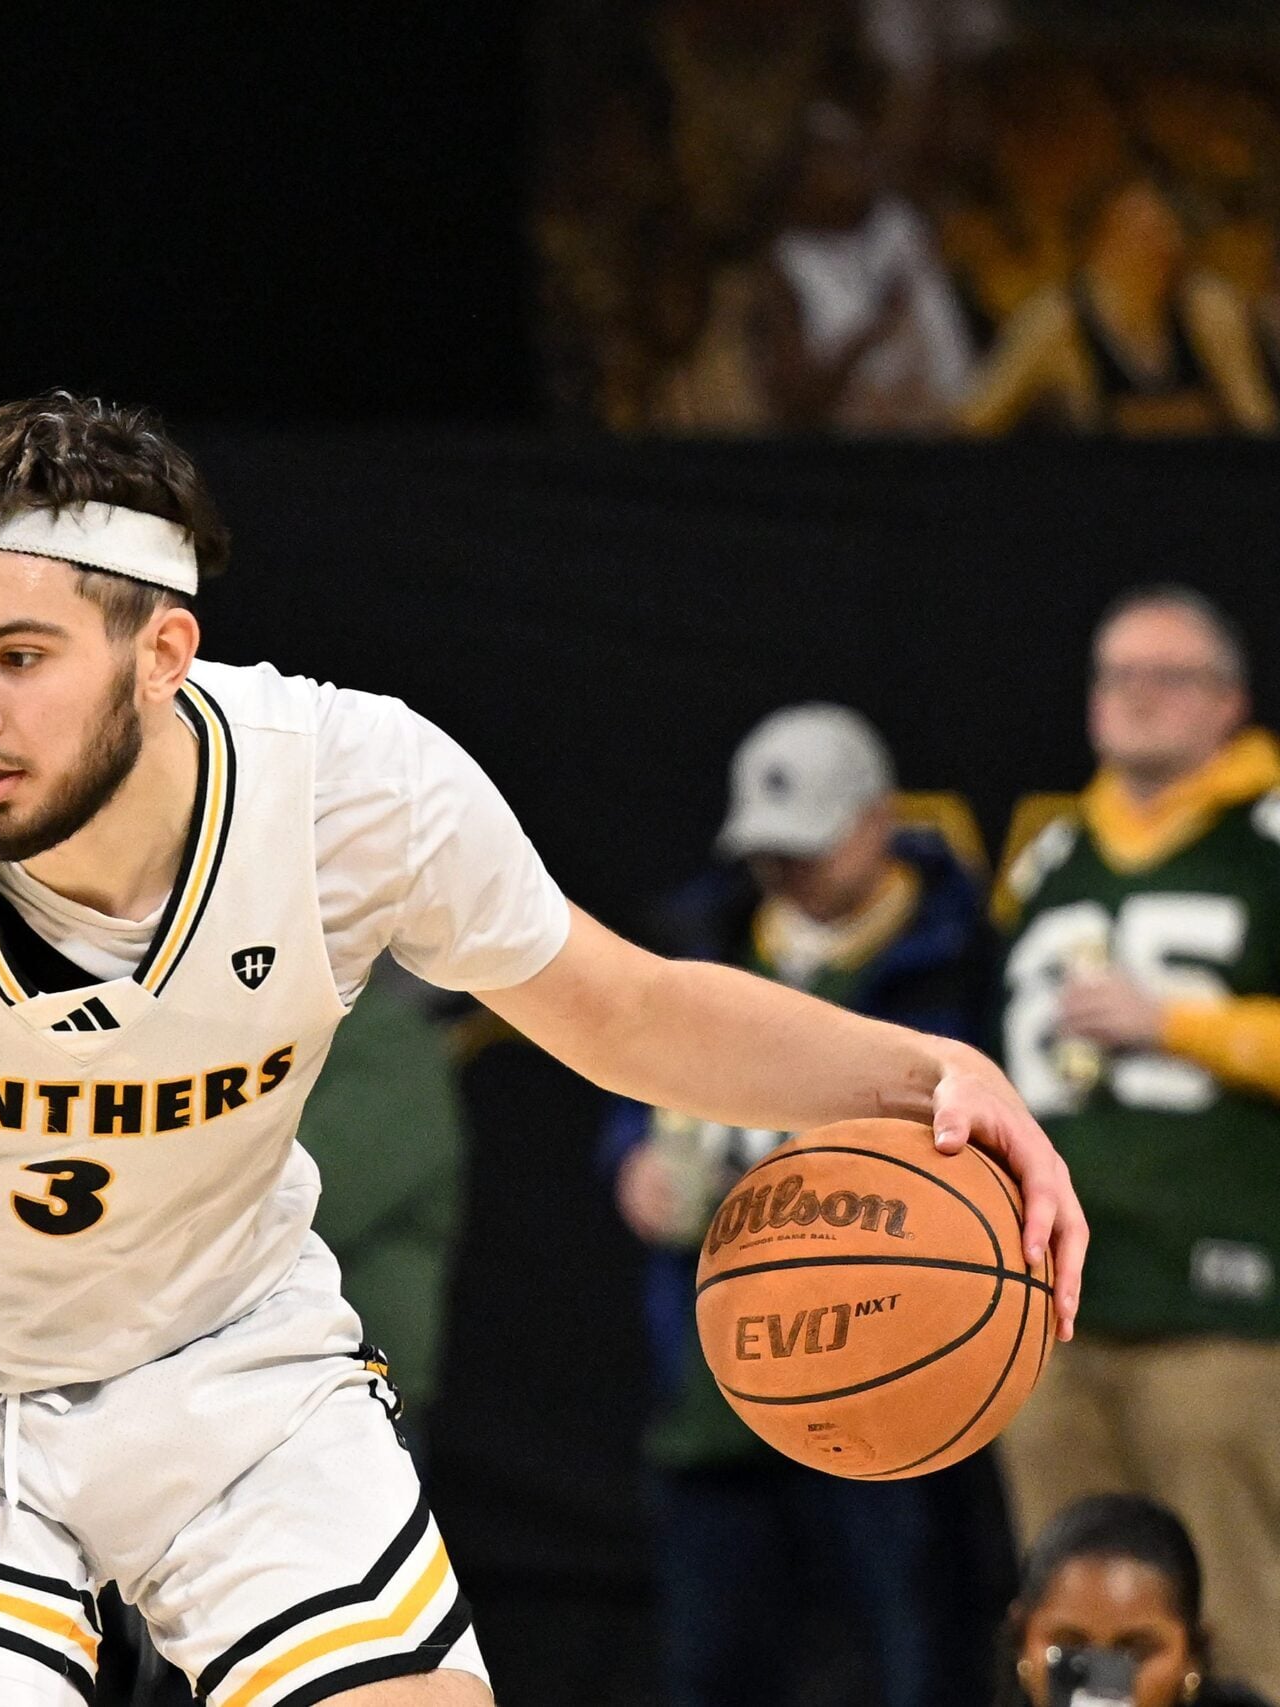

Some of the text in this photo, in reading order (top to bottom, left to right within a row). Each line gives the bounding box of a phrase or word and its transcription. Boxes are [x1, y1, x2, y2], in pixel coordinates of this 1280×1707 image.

[10, 1157, 115, 1237] 3
[709, 1174, 909, 1256] Wilson
[810, 1233, 837, 1241] BALL
[854, 1293, 902, 1318] NXT
